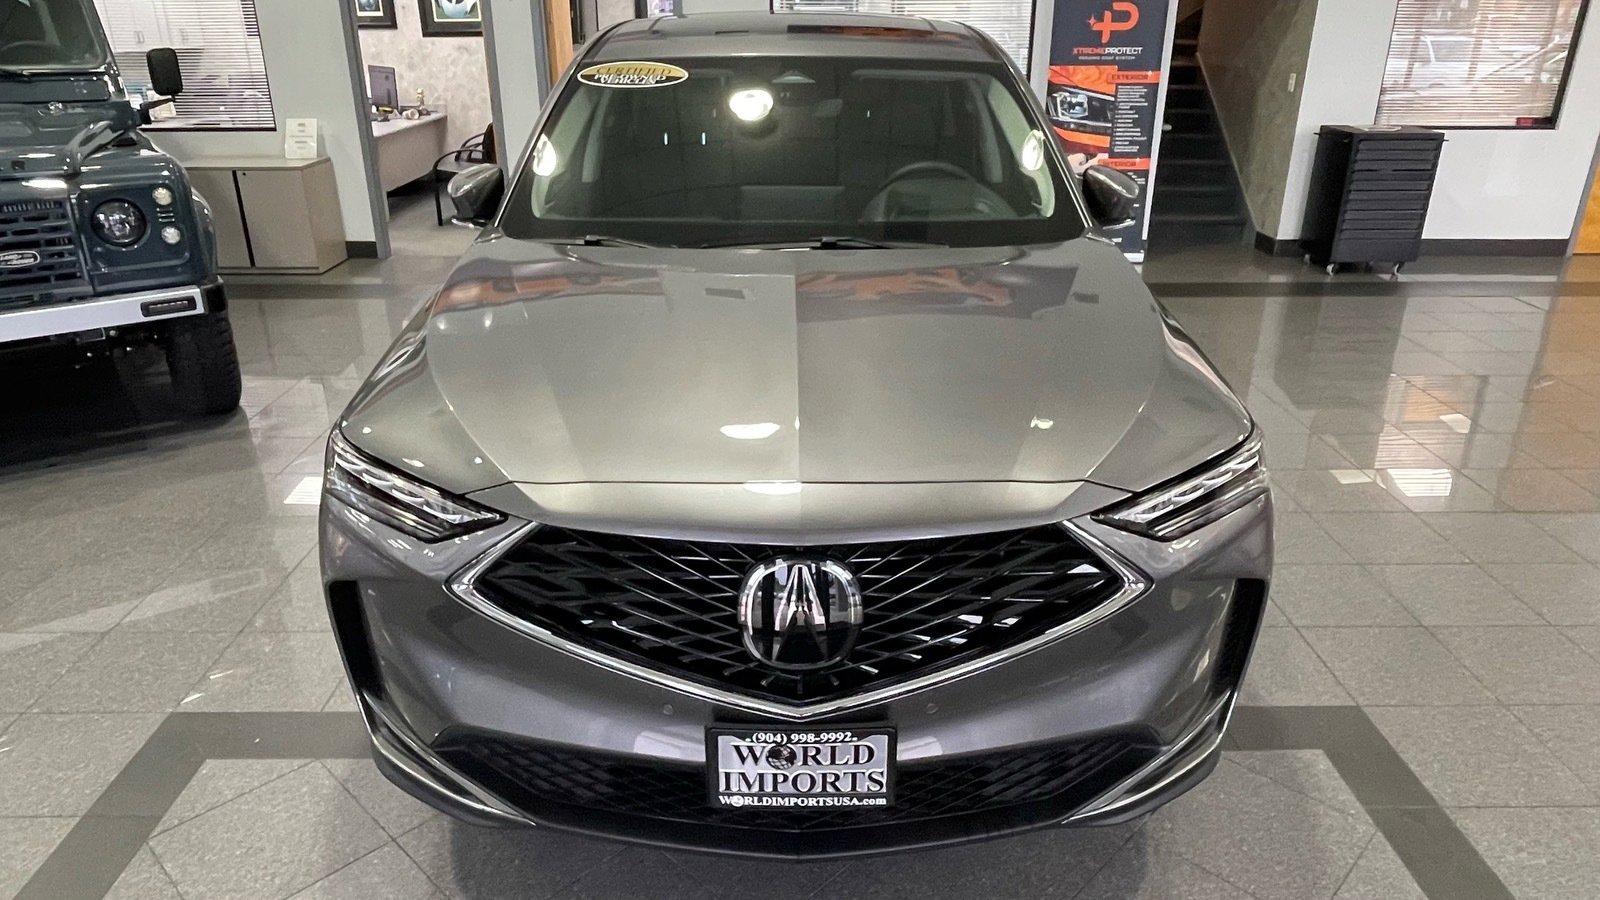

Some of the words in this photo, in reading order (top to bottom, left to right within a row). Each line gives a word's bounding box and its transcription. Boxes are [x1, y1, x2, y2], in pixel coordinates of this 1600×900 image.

[752, 733, 788, 744] (904)
[790, 732, 852, 743] 998-9992
[730, 743, 876, 770] WORLD
[719, 770, 885, 793] IMPORTS
